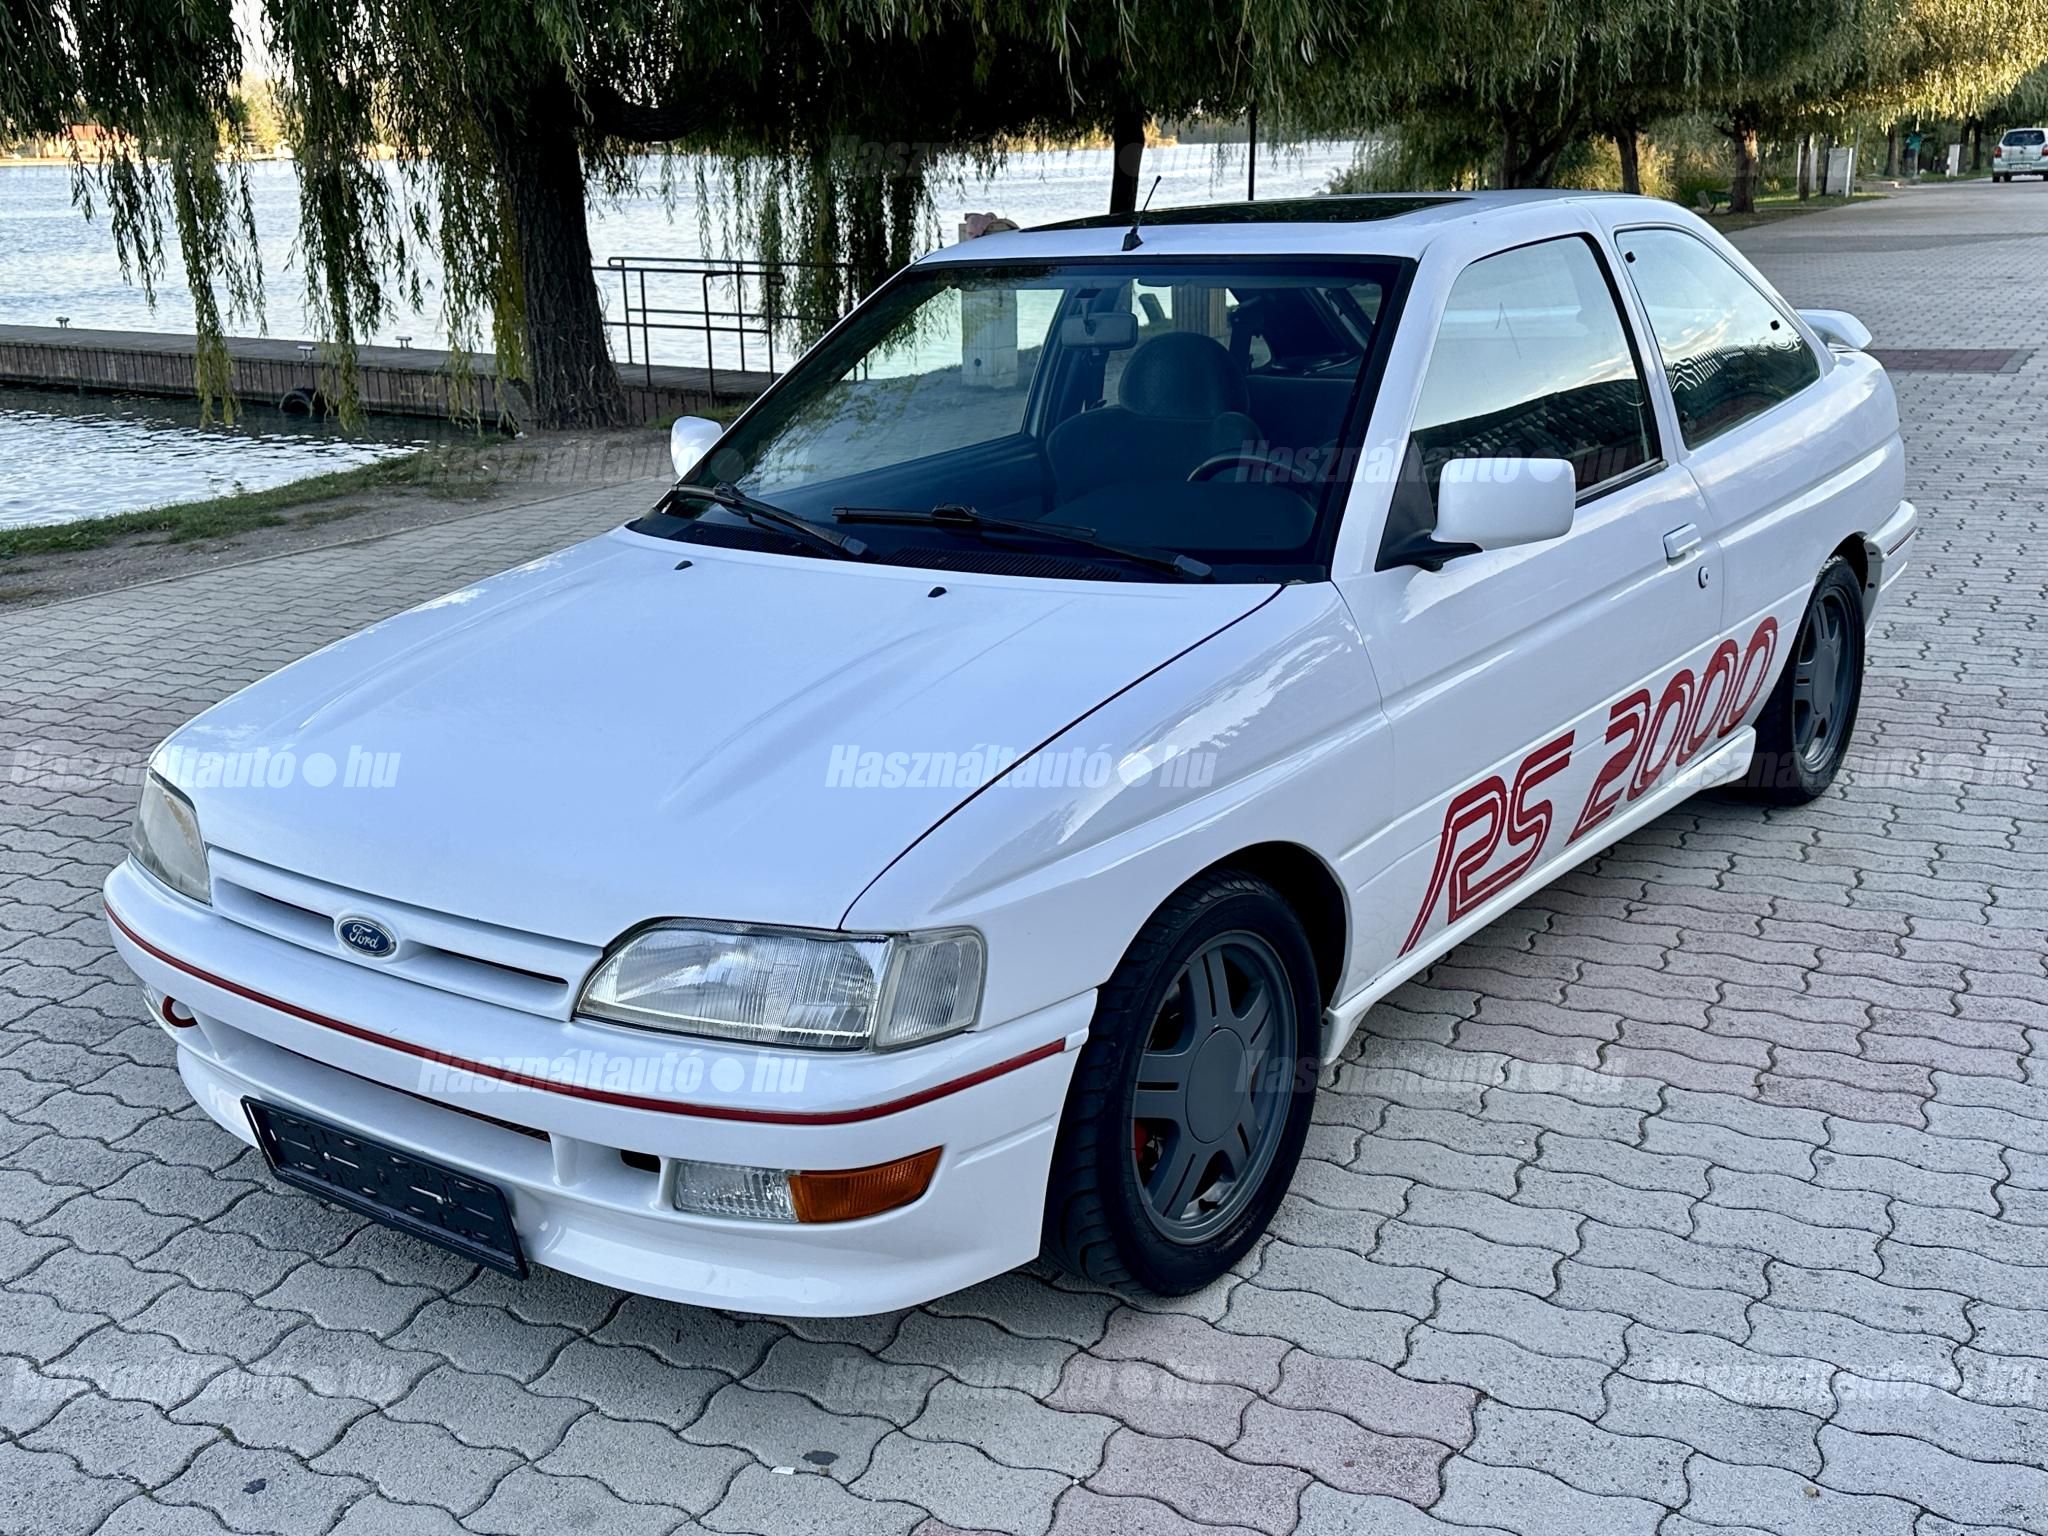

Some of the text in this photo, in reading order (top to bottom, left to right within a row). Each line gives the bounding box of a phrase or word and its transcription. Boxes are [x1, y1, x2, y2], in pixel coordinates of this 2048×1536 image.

[1397, 616, 1778, 959] RS 2000
[349, 923, 381, 949] Ford
